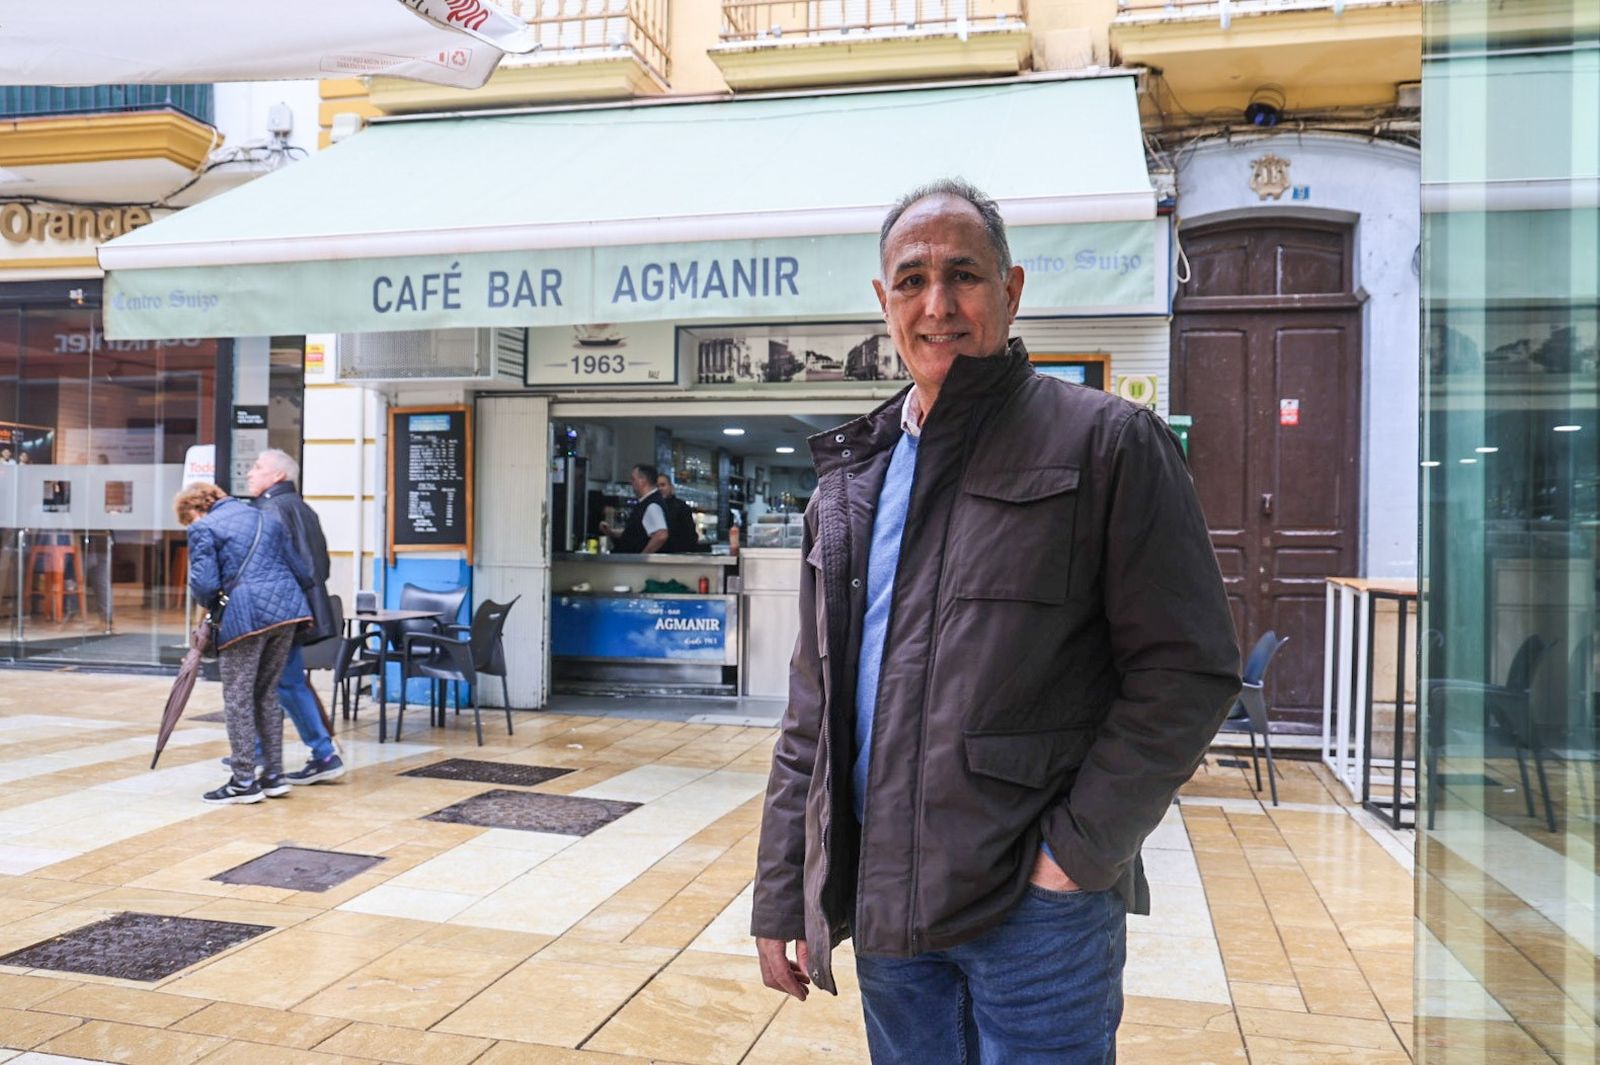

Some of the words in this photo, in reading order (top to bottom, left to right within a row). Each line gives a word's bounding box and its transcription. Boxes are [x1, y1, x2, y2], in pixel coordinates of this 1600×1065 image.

[0, 202, 152, 243] Orange
[1073, 248, 1142, 276] Suizo
[373, 261, 462, 314] CAFÉ
[488, 268, 563, 308] BAR
[612, 256, 800, 304] AGMANIR
[111, 291, 162, 311] Centro
[168, 289, 219, 312] Suizo
[570, 354, 626, 375] 1963
[655, 617, 721, 632] AGMANIR
